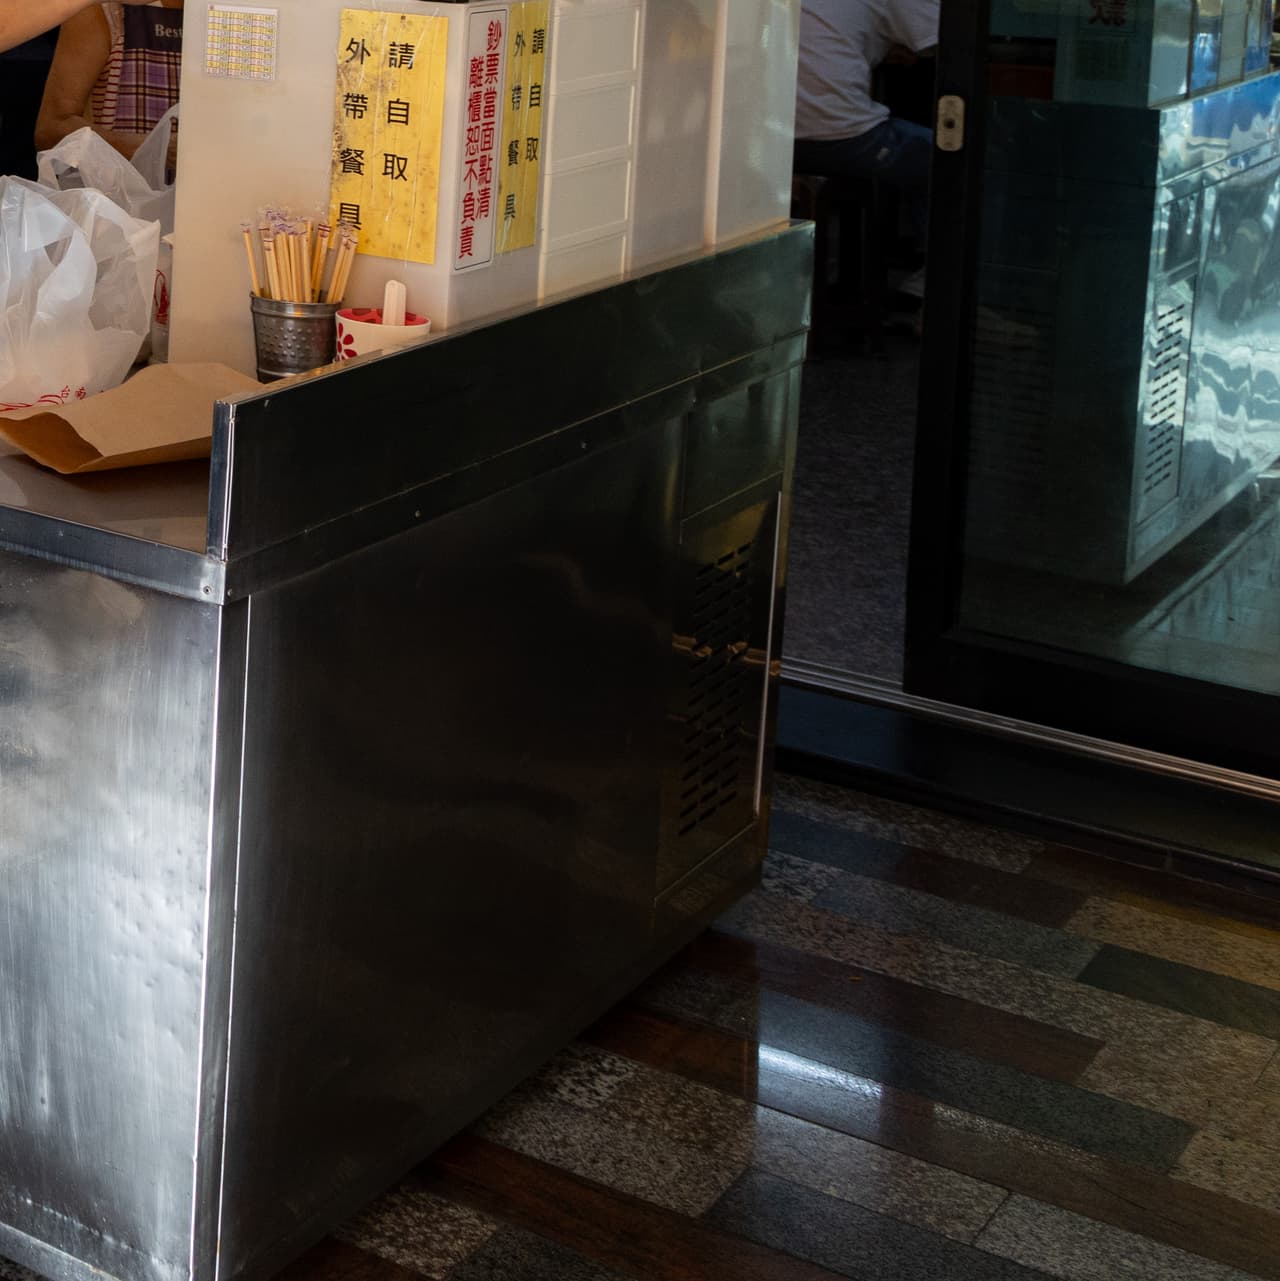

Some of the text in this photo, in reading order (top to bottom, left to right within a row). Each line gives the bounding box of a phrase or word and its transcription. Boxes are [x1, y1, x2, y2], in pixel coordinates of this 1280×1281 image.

[338, 37, 371, 231] 外帶餐具
[382, 41, 415, 182] 請自取
[458, 56, 484, 259] 離櫃恕不負責
[475, 20, 502, 219] 鈔票當面點清
